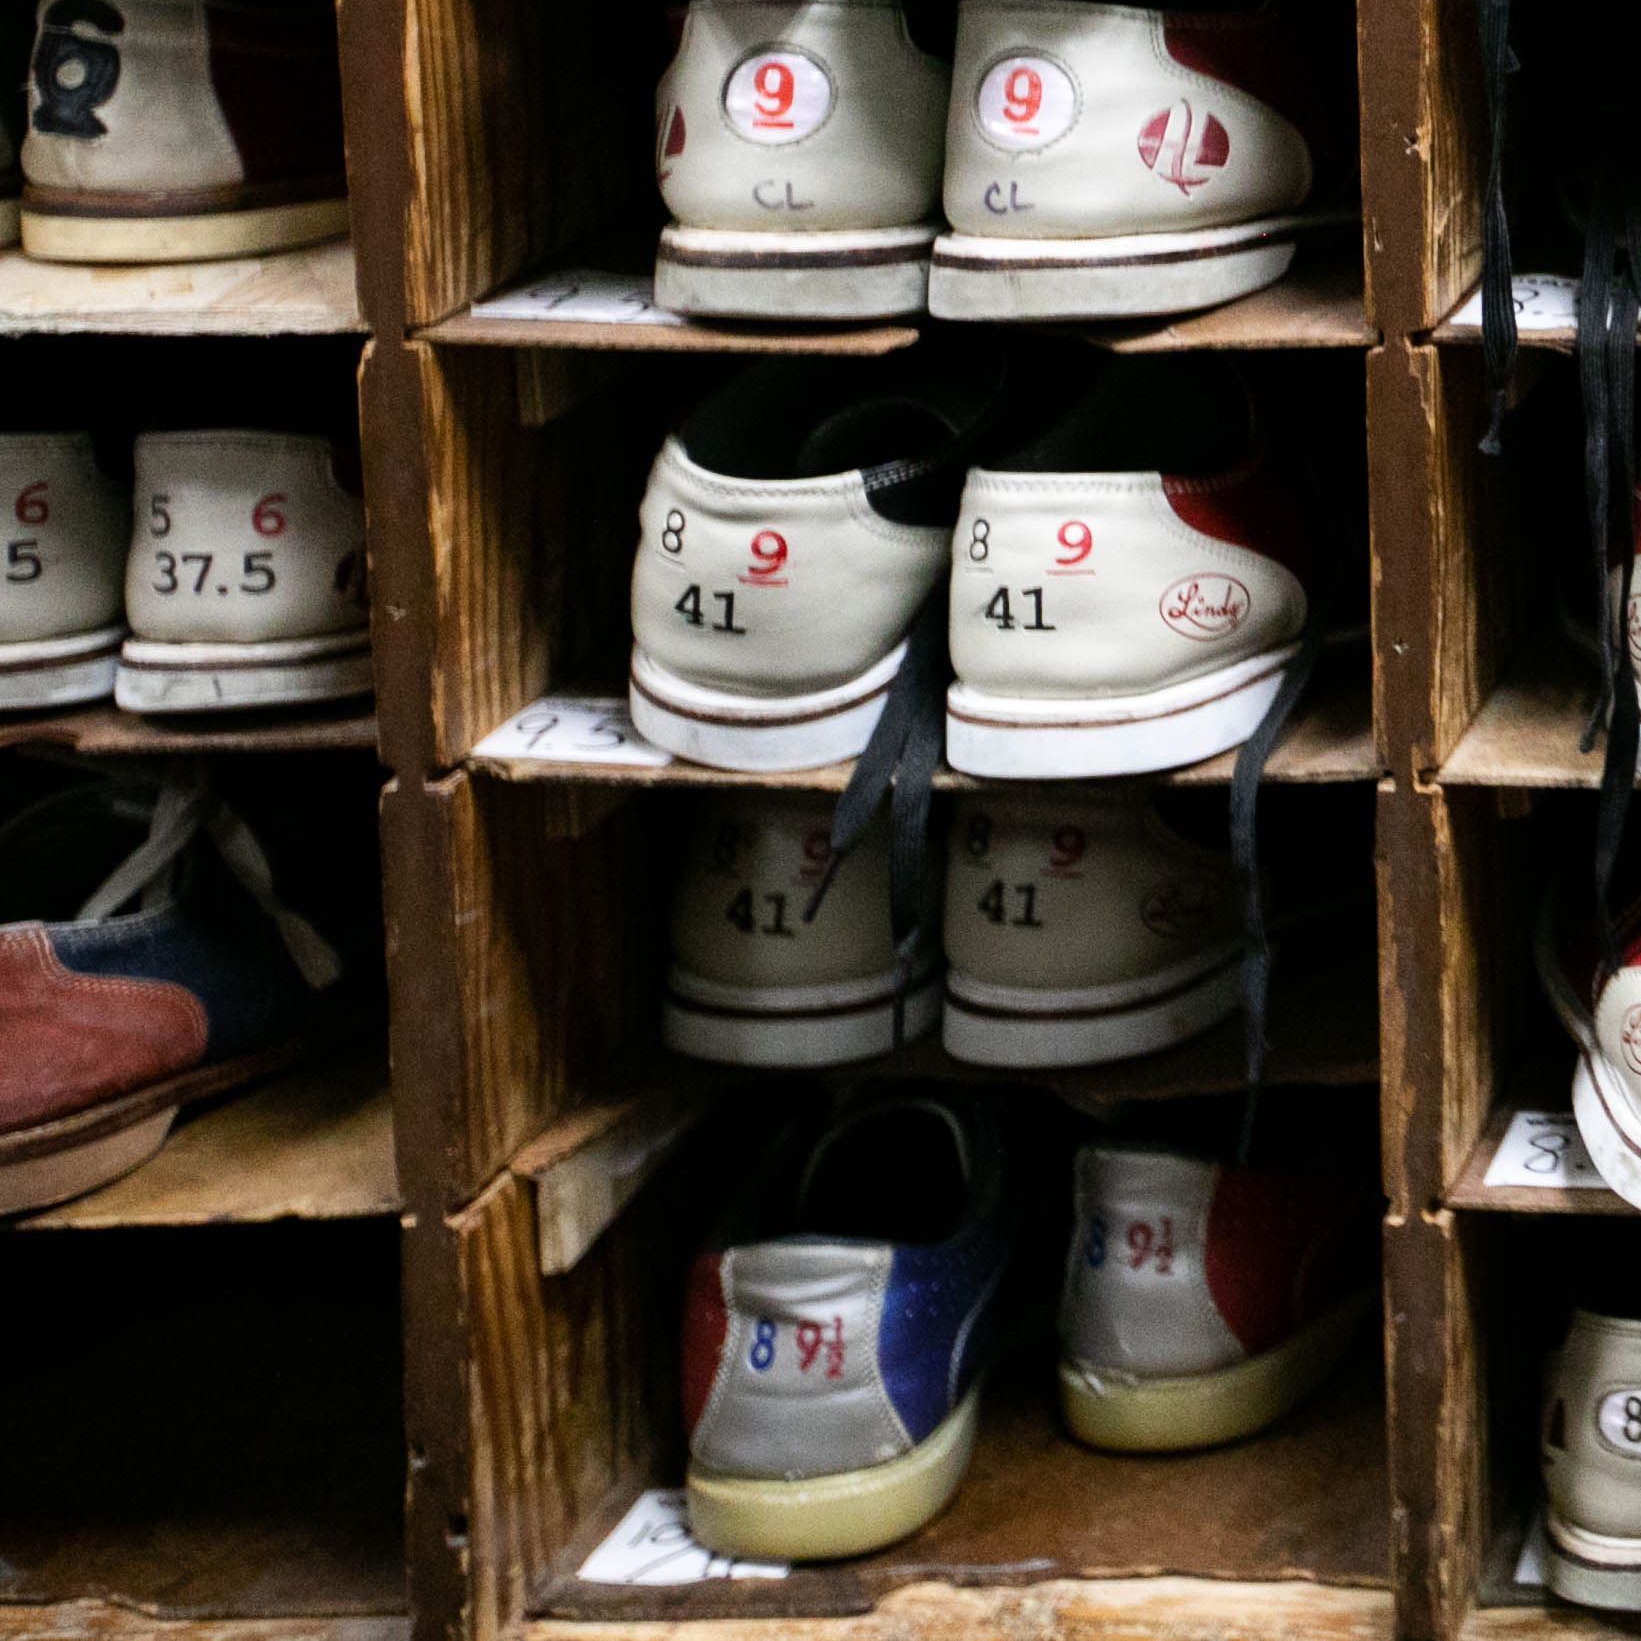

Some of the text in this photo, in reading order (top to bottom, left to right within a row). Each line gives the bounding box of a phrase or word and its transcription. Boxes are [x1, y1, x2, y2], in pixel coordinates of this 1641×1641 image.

[753, 62, 795, 117] 9
[1004, 68, 1042, 123] 9
[15, 482, 49, 525] 6
[150, 494, 287, 538] 5 6
[661, 510, 788, 575] 8 9
[969, 519, 1092, 564] 8 9
[153, 552, 276, 595] 37.5
[675, 584, 745, 635] 41
[985, 587, 1055, 631] 41
[1052, 824, 1086, 868] 9
[727, 890, 794, 938] 41
[978, 881, 1042, 928] 41
[751, 1319, 773, 1371] 8
